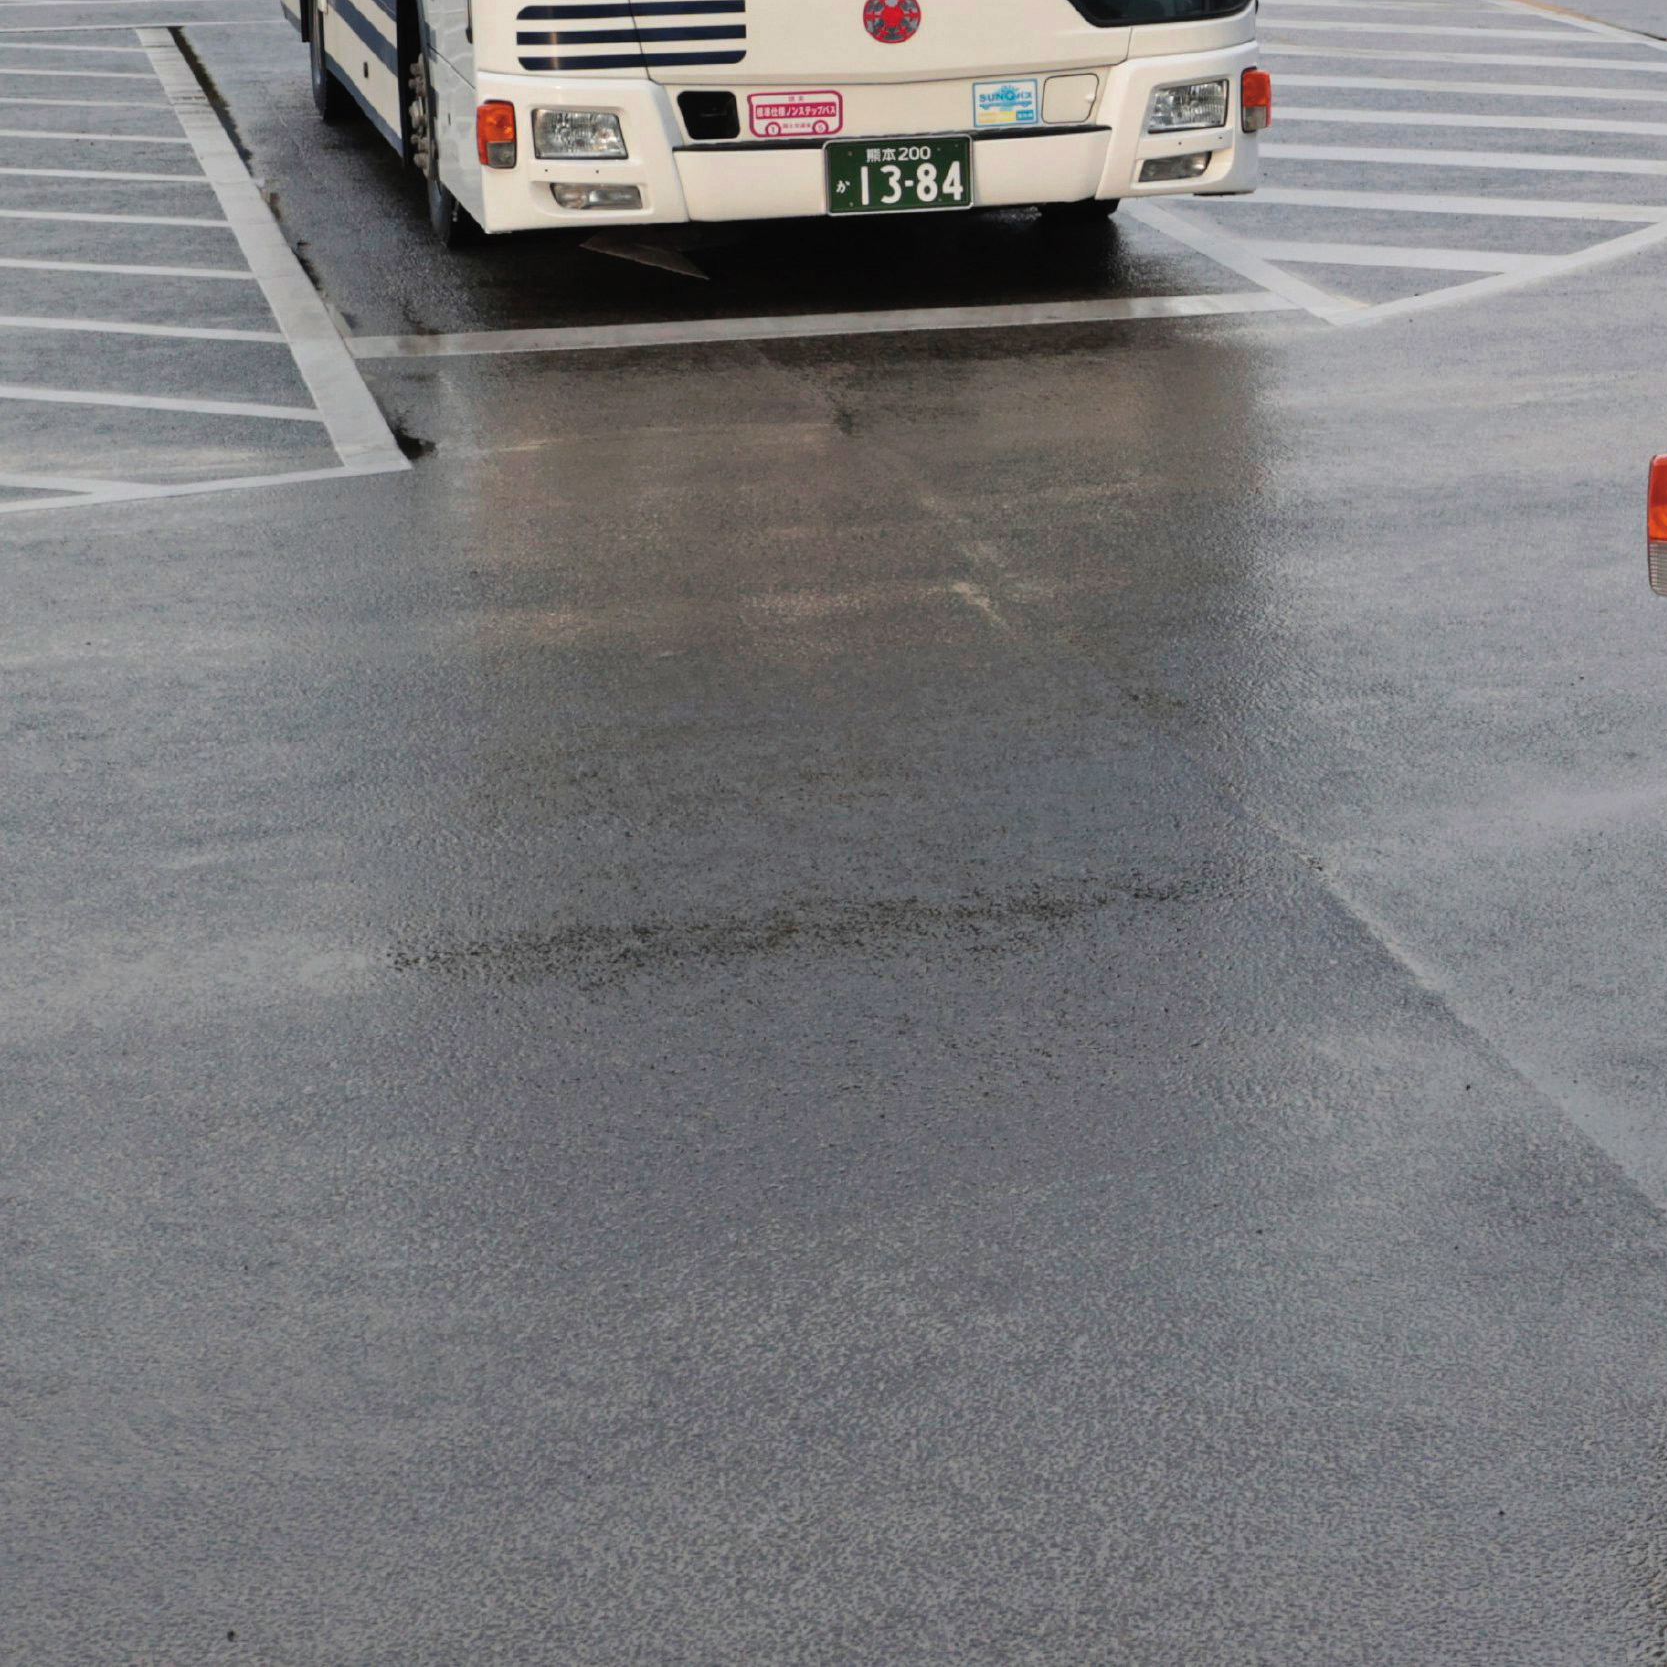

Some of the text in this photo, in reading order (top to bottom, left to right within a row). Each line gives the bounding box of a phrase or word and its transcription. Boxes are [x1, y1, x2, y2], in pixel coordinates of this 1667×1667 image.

[866, 146, 931, 163] 熊本200
[836, 161, 964, 206] か 13-84
